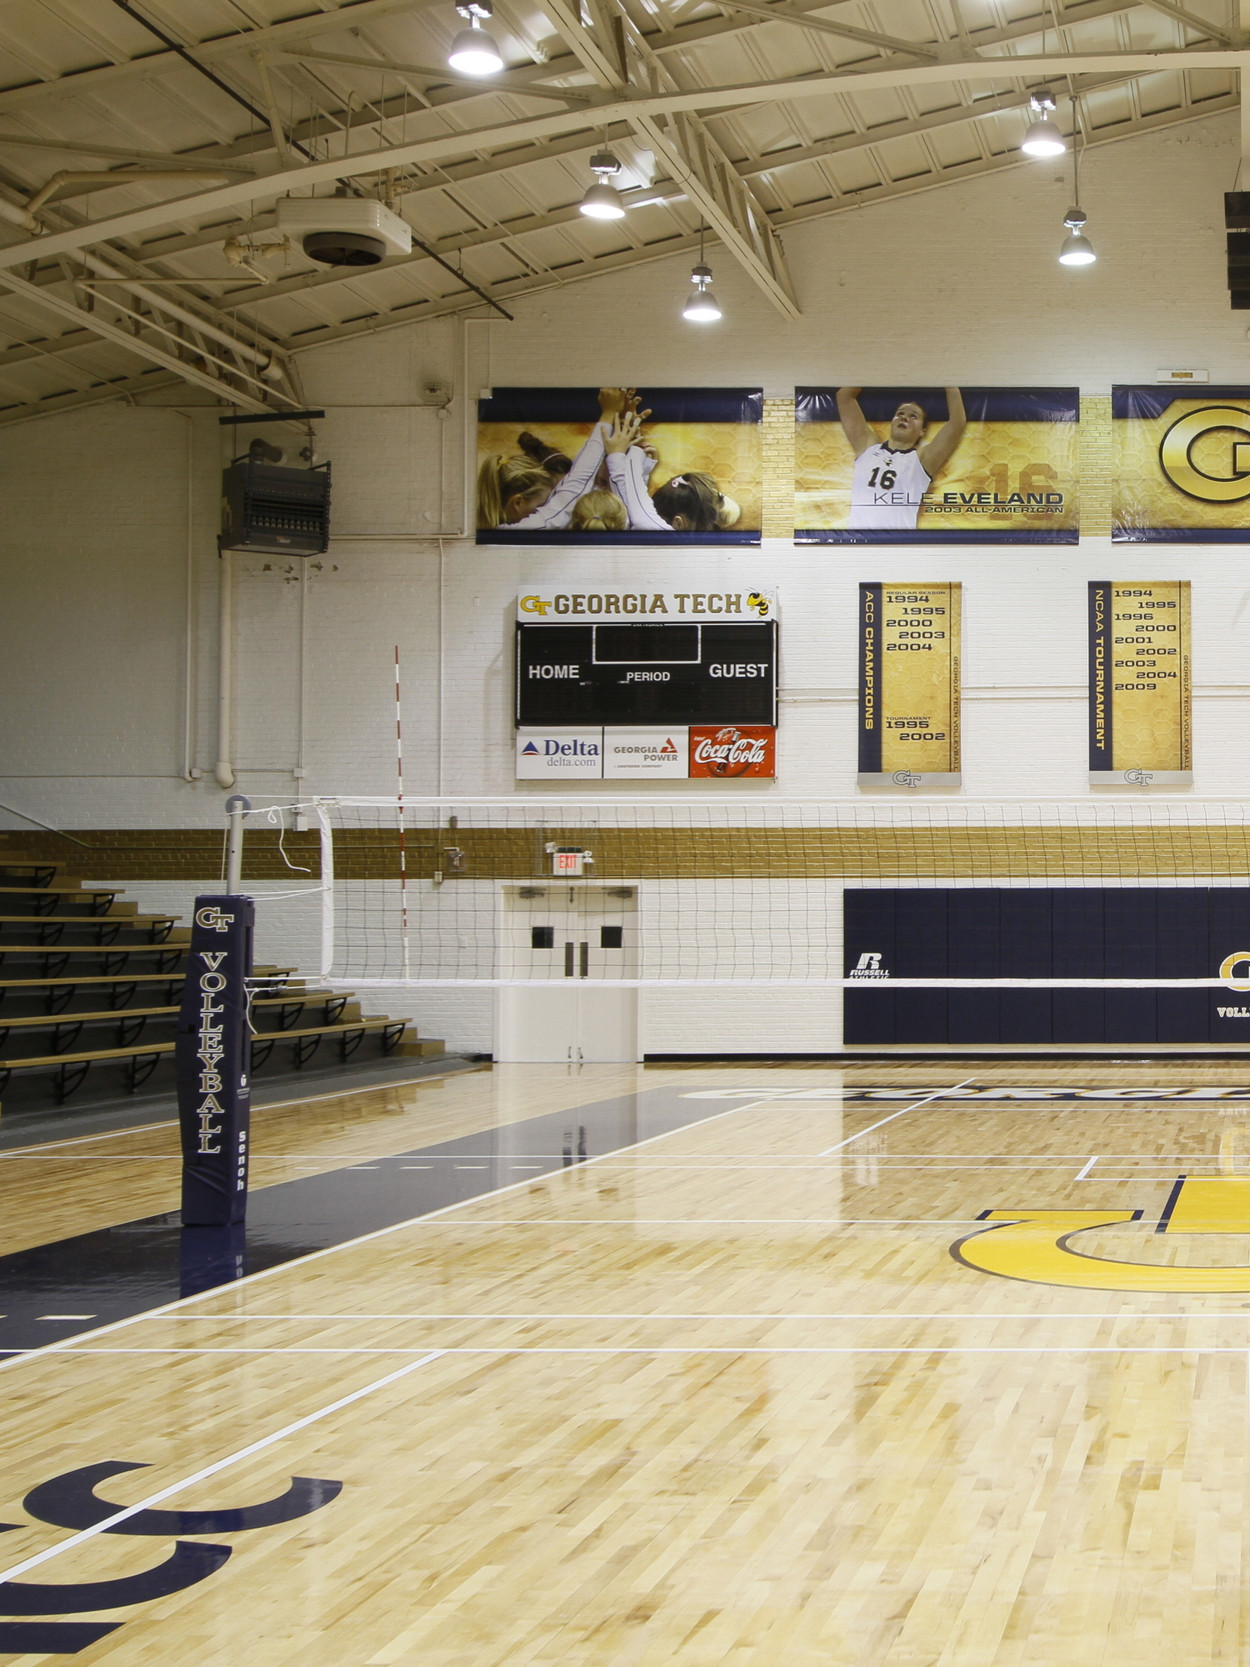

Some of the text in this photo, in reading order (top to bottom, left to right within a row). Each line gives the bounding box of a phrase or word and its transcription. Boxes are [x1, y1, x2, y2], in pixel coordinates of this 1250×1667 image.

[868, 467, 897, 490] 16
[874, 492, 1064, 504] KELE EVELAND
[520, 594, 742, 616] GT GEORGIA TECH
[886, 595, 930, 604] 1994
[865, 591, 874, 730] ACC CHAMPIONS
[1095, 590, 1104, 750] NCAA TOURNAMENT
[528, 665, 580, 679] HOME
[626, 672, 670, 681] PERIOD
[709, 664, 768, 678] GUEST
[544, 739, 599, 756] Delta
[694, 739, 768, 763] Coca-Cola
[547, 757, 596, 767] delta.com
[559, 854, 578, 868] EXIT
[196, 907, 234, 932] GT
[197, 952, 227, 1154] VOLLEYBALL
[237, 1131, 246, 1191] senoh
